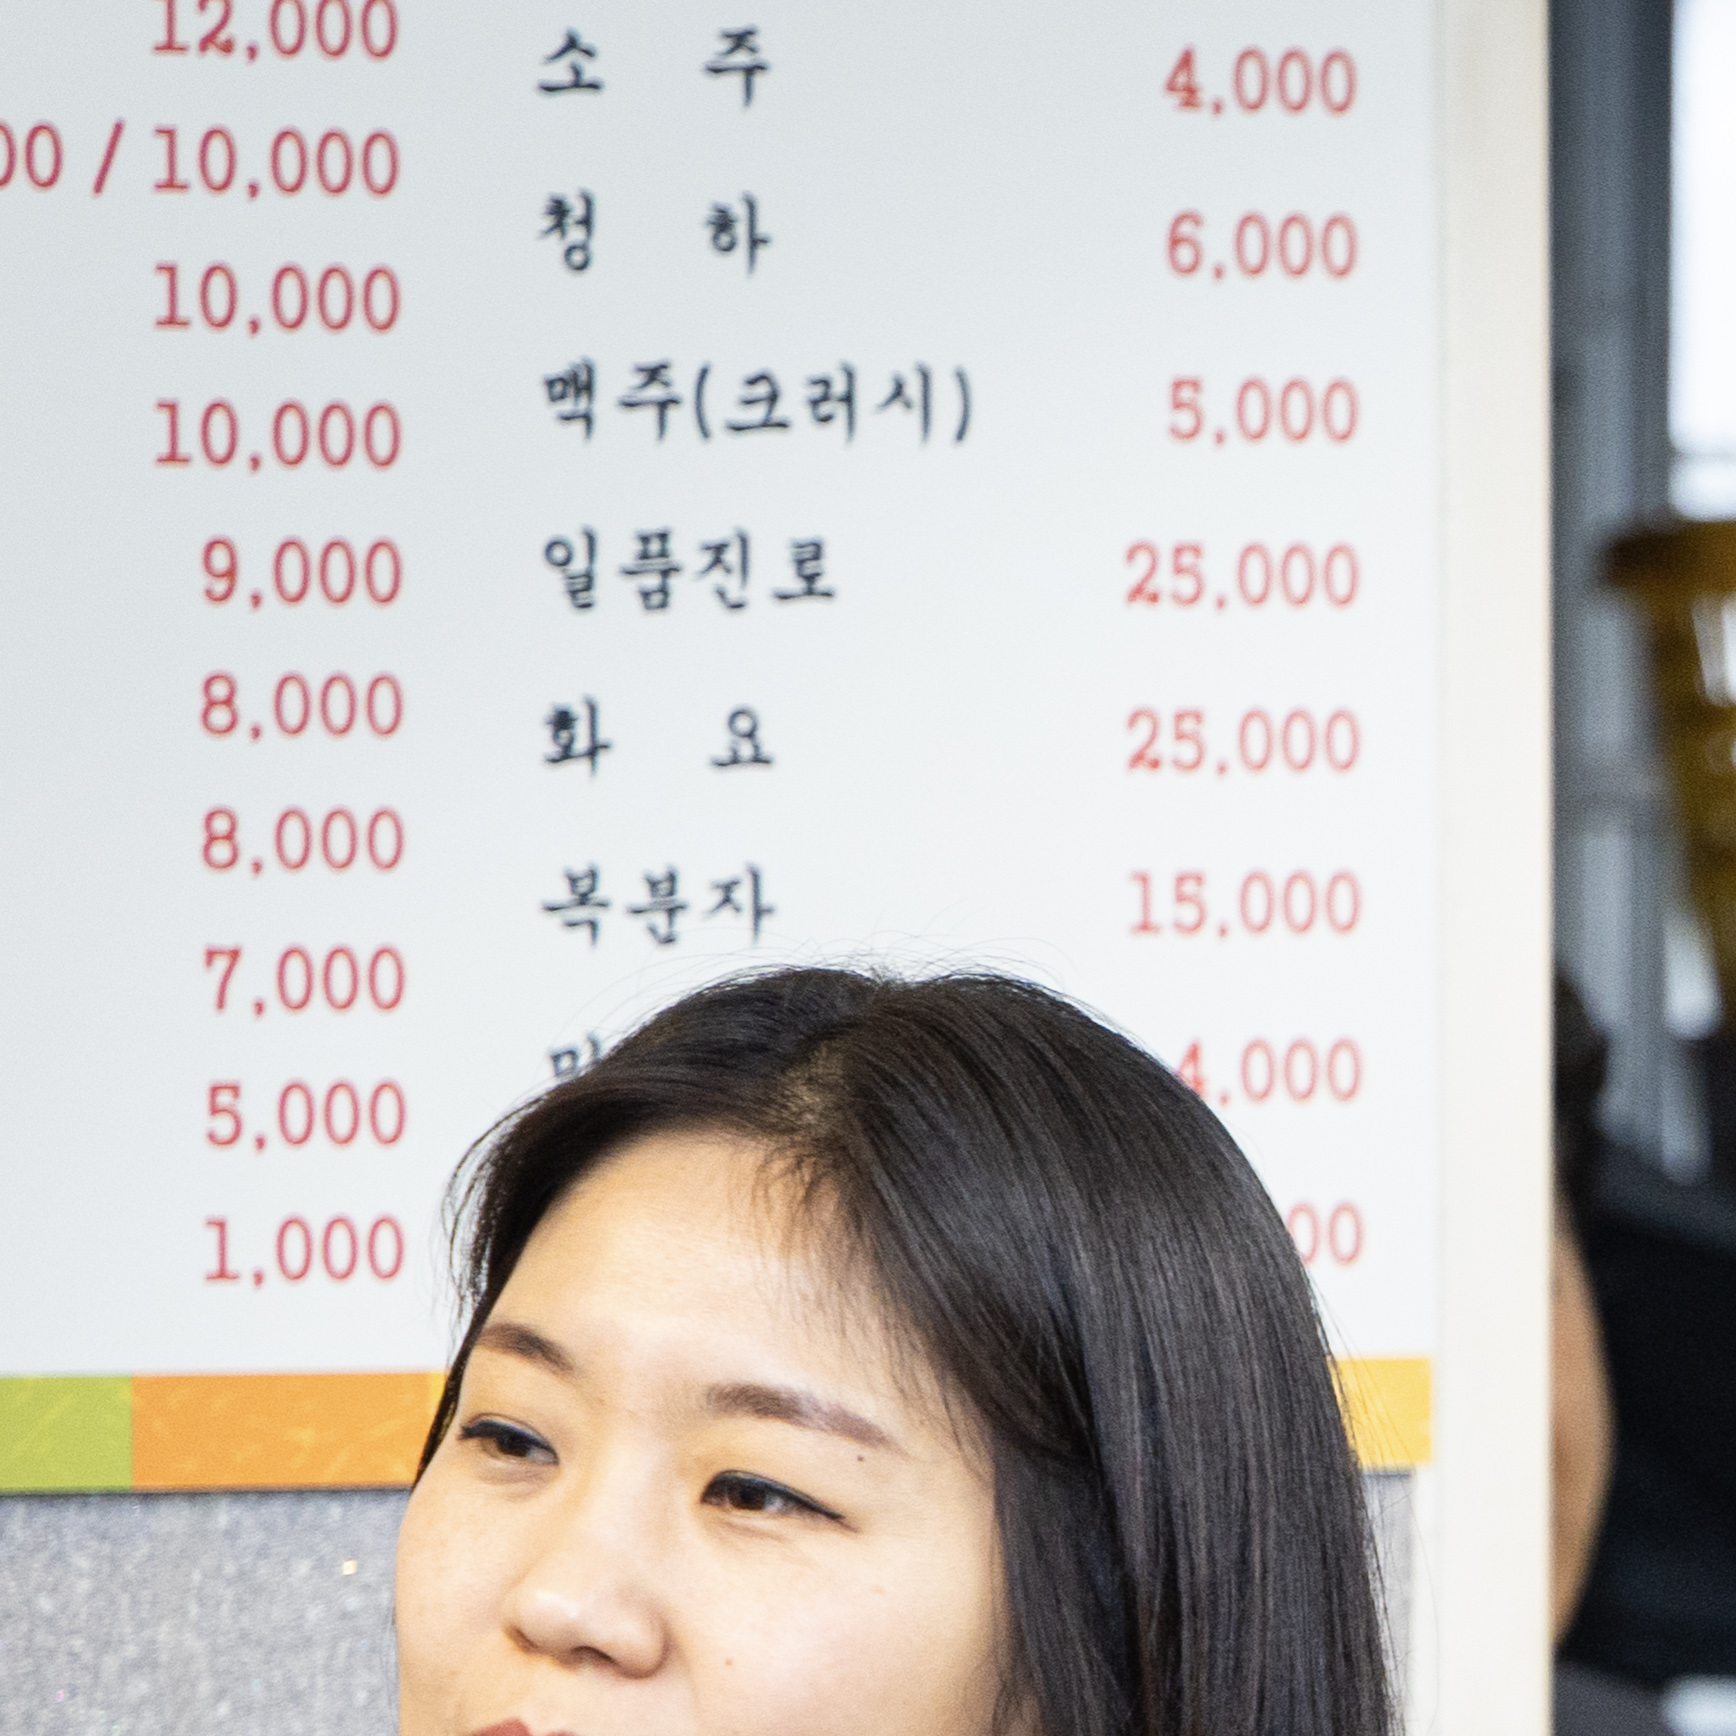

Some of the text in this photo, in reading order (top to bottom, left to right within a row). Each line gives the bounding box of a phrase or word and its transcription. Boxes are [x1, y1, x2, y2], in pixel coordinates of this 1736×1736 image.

[152, 0, 400, 63] 12,000
[1163, 46, 1358, 116] 4,000
[153, 126, 401, 200] 10,000
[1166, 210, 1359, 281] 6,000
[155, 262, 402, 337] 10,000
[155, 399, 403, 474] 10,000
[1169, 377, 1359, 446] 5,000
[201, 536, 405, 611] 9,000
[543, 526, 837, 613] 일품진로
[1125, 540, 1360, 611] 25,000
[200, 672, 405, 742] 8,000
[1126, 708, 1360, 776] 25,000
[201, 806, 405, 877] 8,000
[541, 862, 777, 949] 복분자
[1129, 871, 1362, 939] 15,000
[203, 945, 407, 1018] 7,000
[206, 1080, 408, 1154] 5,000
[204, 1215, 406, 1288] 1,000
